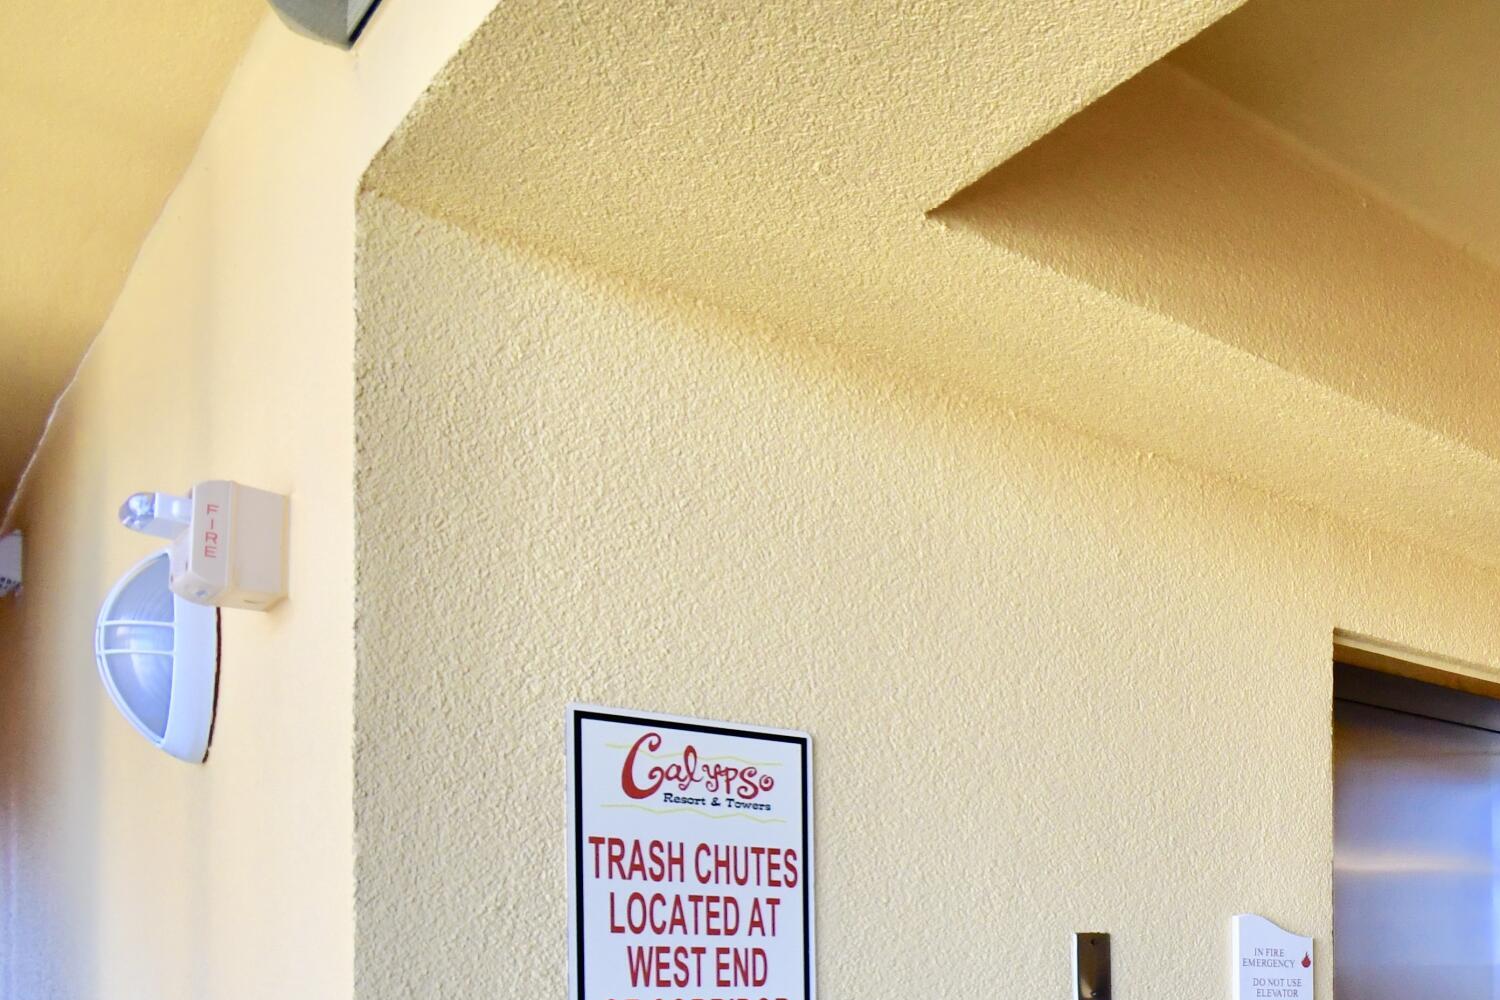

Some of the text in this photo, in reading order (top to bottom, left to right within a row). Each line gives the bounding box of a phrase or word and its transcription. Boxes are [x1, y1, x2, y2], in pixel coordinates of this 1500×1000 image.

[204, 503, 220, 558] FIRE
[621, 732, 775, 800] Calypso
[663, 792, 772, 811] Resort & Towers
[588, 836, 799, 888] TRASH CHUTES
[609, 891, 781, 937] LOCATED AT
[627, 945, 768, 987] WEST END
[1242, 958, 1295, 968] EMERGENCY
[1254, 947, 1285, 957] IN FIRE
[1252, 978, 1303, 987] DO NOT USE
[1256, 989, 1299, 998] ELEVATOR
